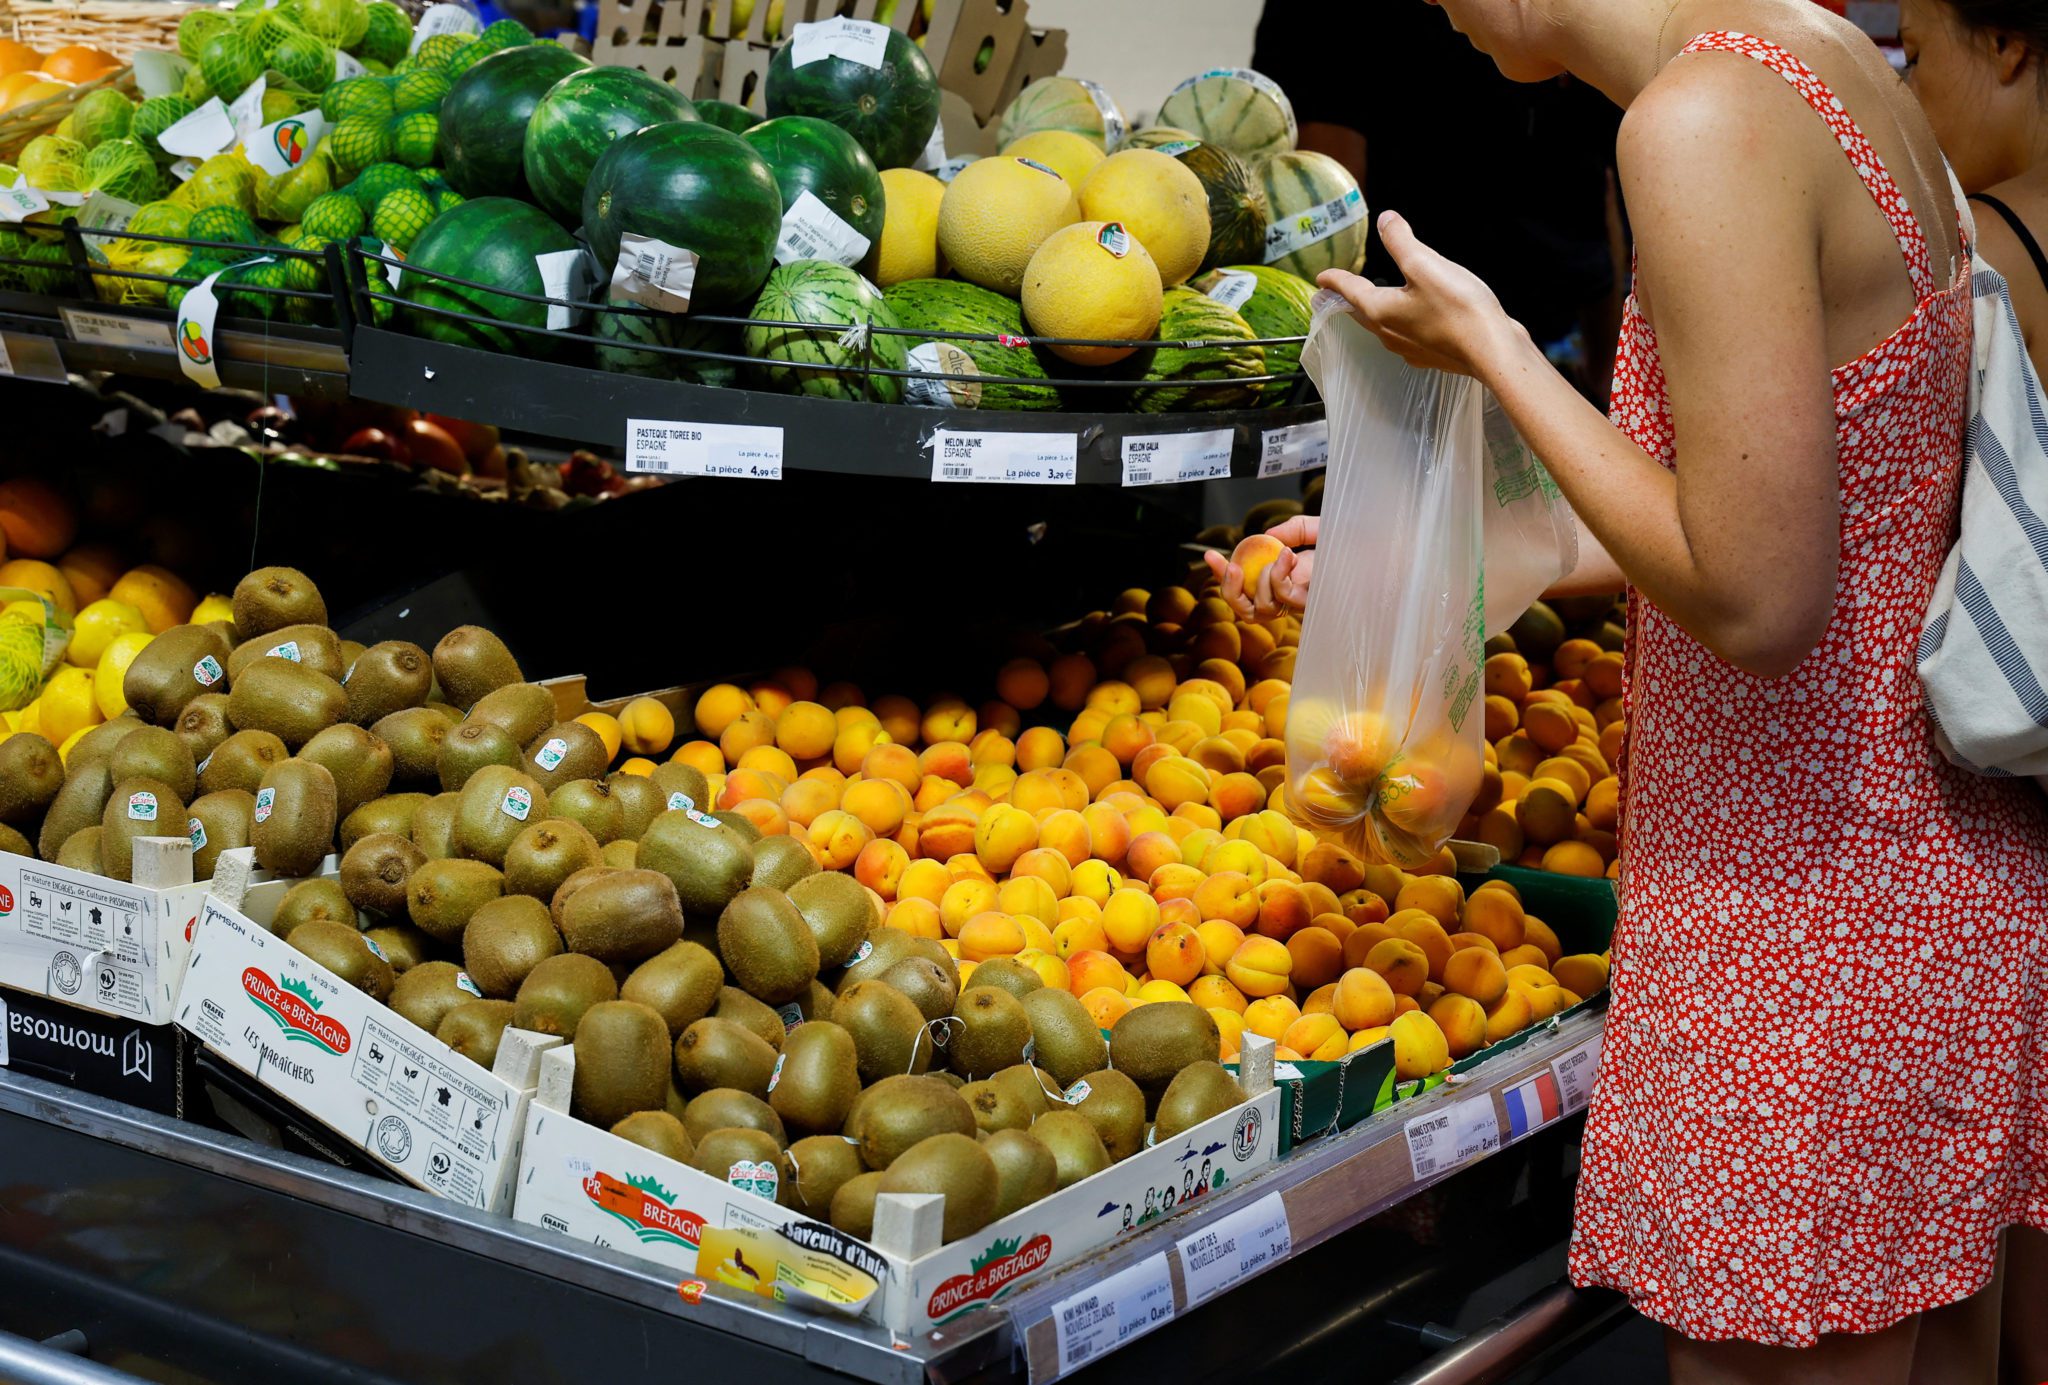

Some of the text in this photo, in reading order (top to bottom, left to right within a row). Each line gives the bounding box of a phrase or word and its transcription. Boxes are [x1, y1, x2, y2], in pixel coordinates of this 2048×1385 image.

[637, 429, 702, 441] PASTEQUE TIGREE BIO
[945, 438, 982, 448] MELON JAUNE
[636, 440, 667, 451] ESPAGNE
[944, 448, 972, 458] ESPAGNE
[1129, 442, 1146, 451] MELON
[1128, 453, 1152, 463] ESPAGNE
[705, 464, 716, 473] La
[719, 464, 743, 475] pièce
[1006, 469, 1017, 477] La
[1018, 469, 1041, 478] pièce
[130, 796, 156, 805] Zespri
[32, 876, 51, 888] Nature
[86, 890, 108, 903] Culture
[206, 905, 265, 948] SAMSON L3
[204, 1001, 225, 1020] ERAFEL
[244, 972, 348, 1050] PRINCE de BRETAGNE
[244, 1026, 315, 1084] LES MARAÎCHERS
[368, 1022, 376, 1032] de
[377, 1029, 400, 1047] Nature
[428, 1061, 437, 1071] de
[438, 1067, 463, 1088] Culture
[1408, 1116, 1449, 1139] ANANAS EXTRA SWEET
[1457, 1149, 1465, 1158] La
[427, 1171, 447, 1186] PEFC
[543, 1216, 568, 1233] ERAFEL
[643, 1202, 702, 1241] BRETAGN
[787, 1222, 843, 1257] Saveurs
[1186, 1243, 1199, 1257] KIWI
[1206, 1233, 1213, 1247] DE
[1190, 1238, 1236, 1273] NOUVELLE ZELANDE
[1240, 1261, 1249, 1271] La
[1249, 1251, 1266, 1269] pièce
[931, 1242, 1049, 1314] PRINCE de BRETAGNE
[1063, 1295, 1099, 1322] KIWI HAYWARD
[1065, 1301, 1116, 1337] NOUVELLE ZELANDE
[1119, 1325, 1128, 1336] La
[1129, 1315, 1147, 1334] pièce
